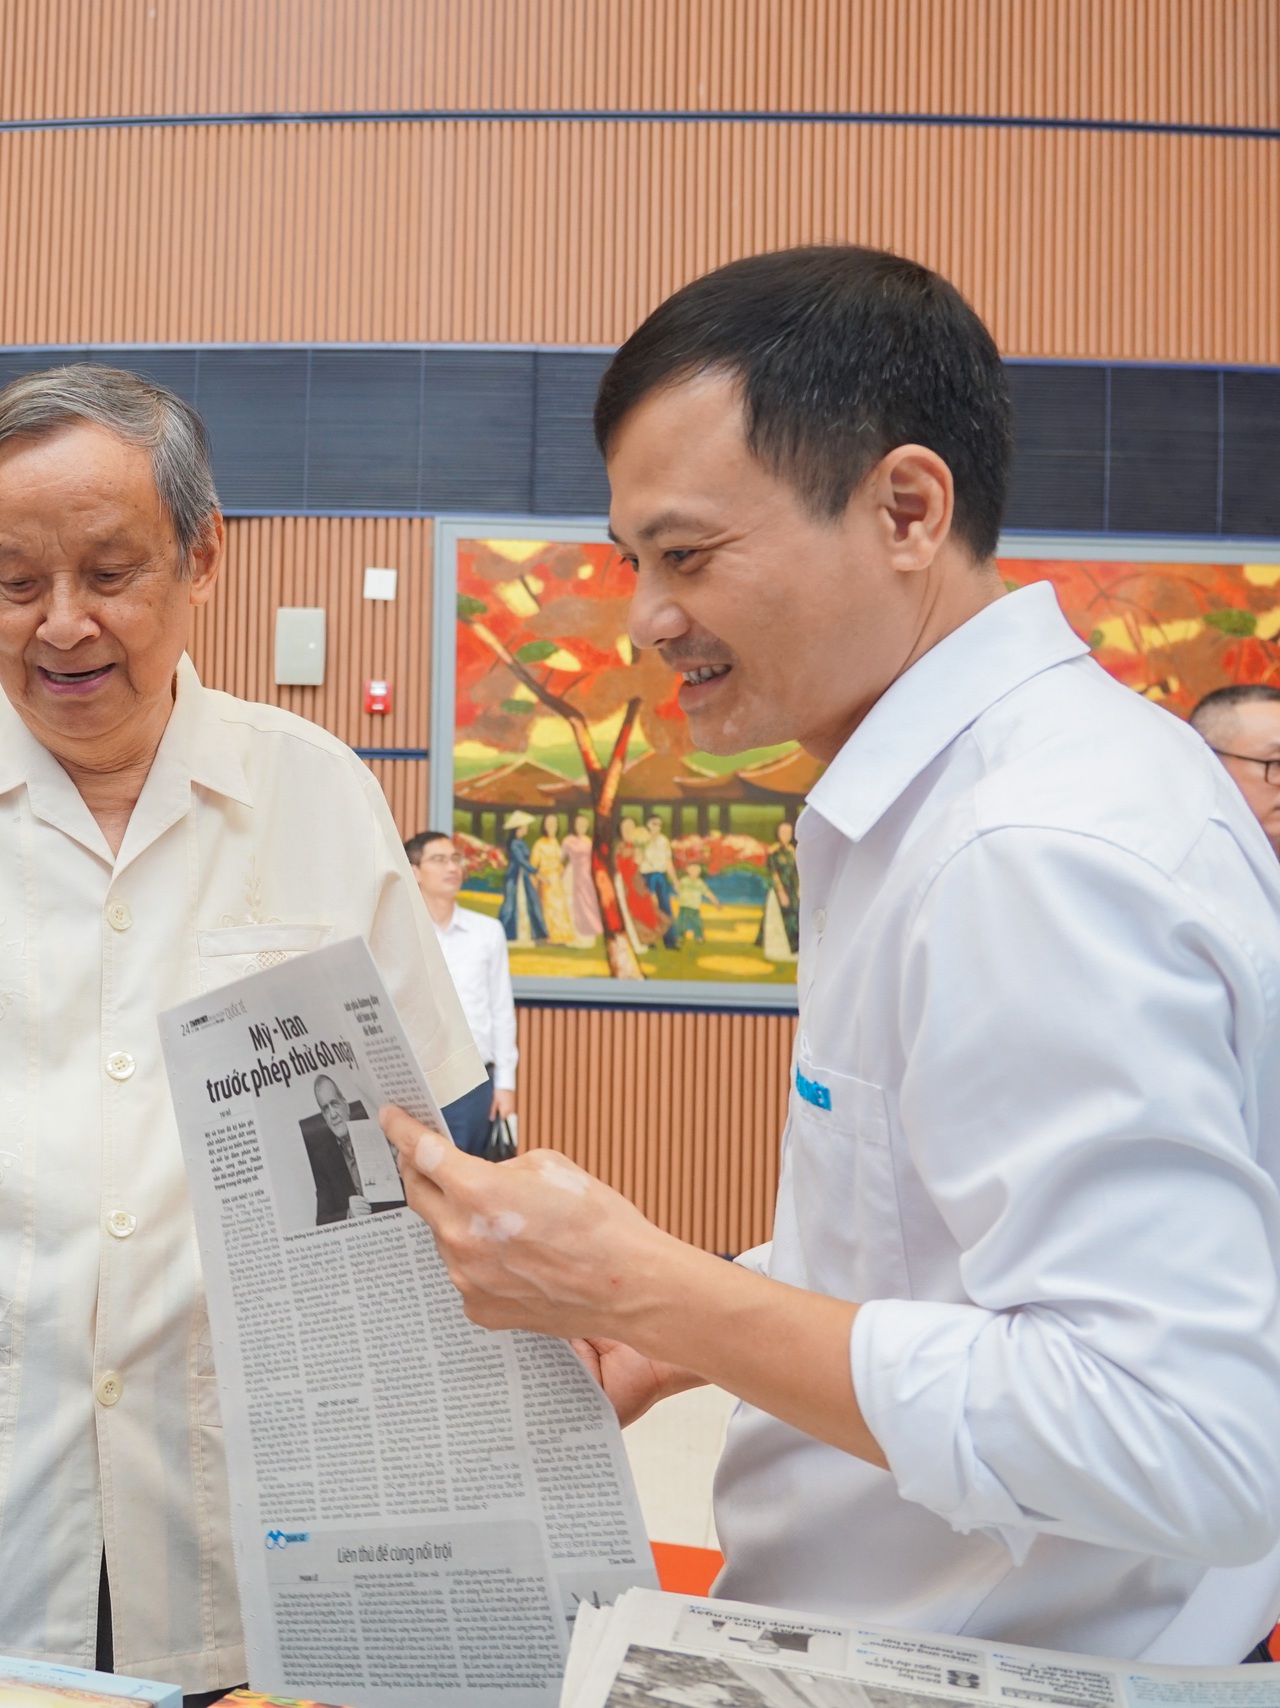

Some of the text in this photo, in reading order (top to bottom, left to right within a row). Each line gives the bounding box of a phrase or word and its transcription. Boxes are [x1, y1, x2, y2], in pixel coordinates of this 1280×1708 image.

[248, 1022, 276, 1053] Mỹ
[275, 1014, 309, 1041] Iran
[206, 1069, 251, 1103] trước
[250, 1055, 291, 1097] phép
[289, 1043, 319, 1076] thử
[315, 1040, 336, 1068] 60
[337, 1547, 358, 1564] Liên
[390, 1546, 415, 1565] cùng
[433, 1541, 452, 1562] trội
